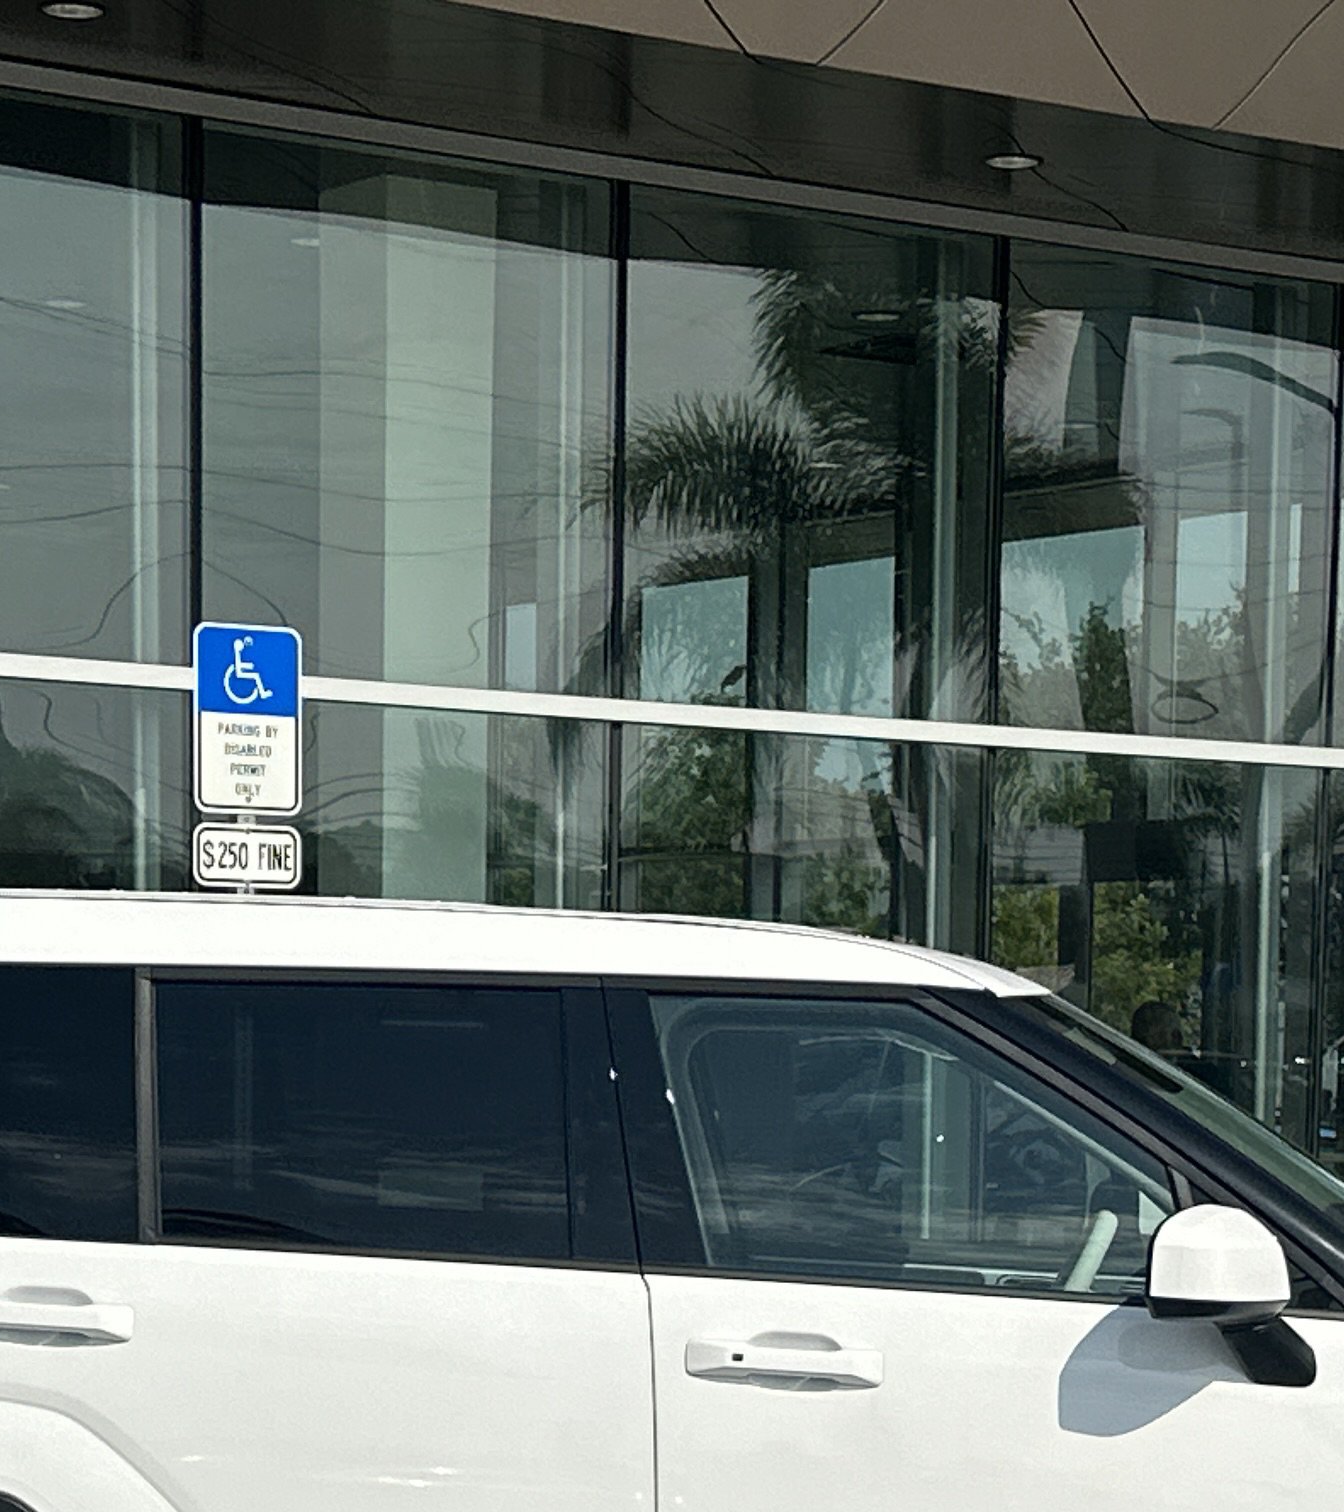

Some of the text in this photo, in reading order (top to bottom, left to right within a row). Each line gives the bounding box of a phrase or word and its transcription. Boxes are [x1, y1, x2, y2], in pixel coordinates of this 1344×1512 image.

[218, 722, 278, 738] PARKING BY
[224, 742, 272, 758] DISABLED
[230, 763, 266, 777] PERMIT
[235, 783, 261, 797] ONLY
[258, 842, 292, 871] FINE
